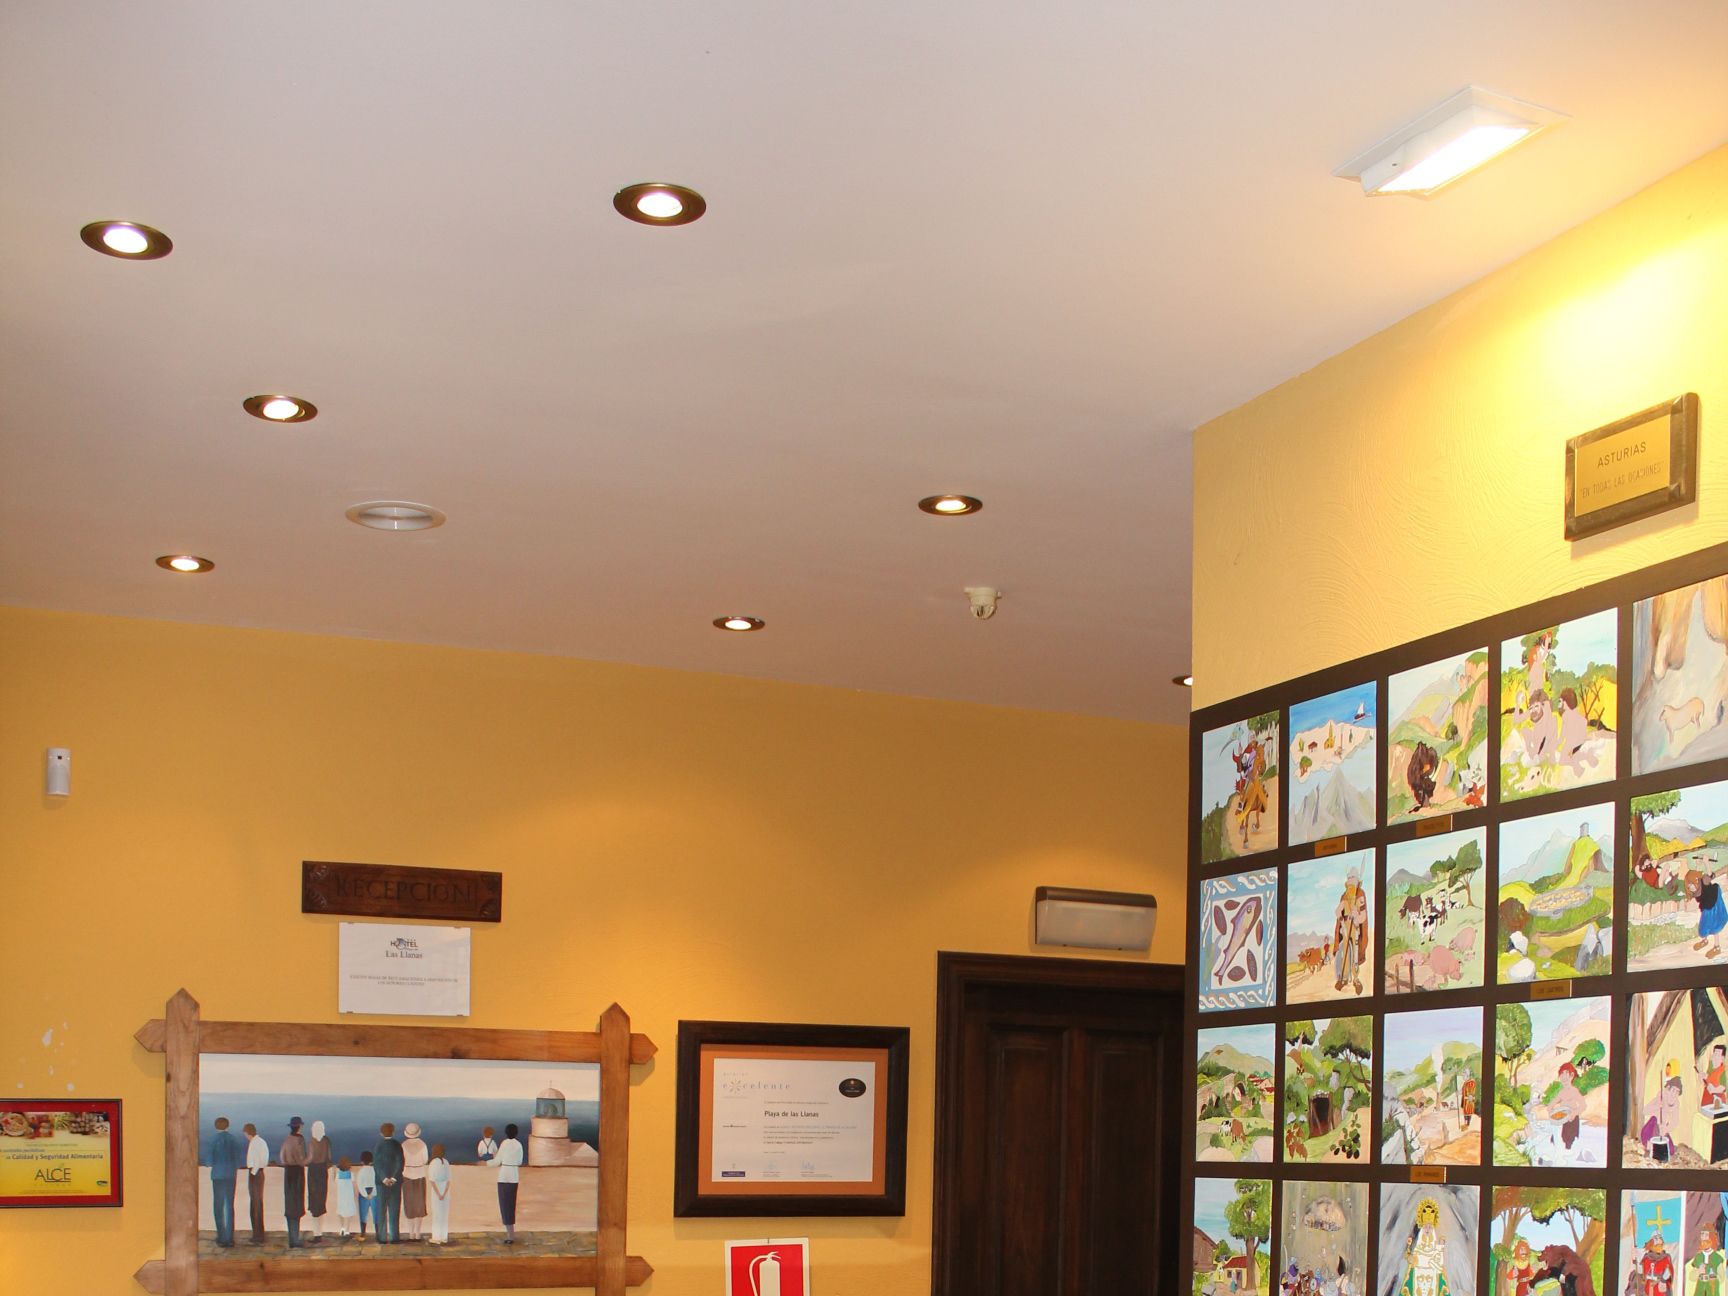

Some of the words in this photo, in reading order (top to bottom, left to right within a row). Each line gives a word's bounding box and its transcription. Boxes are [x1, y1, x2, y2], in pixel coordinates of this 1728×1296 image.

[1597, 441, 1647, 468] ASTURIAS
[764, 1110, 780, 1119] Playa
[781, 1110, 789, 1118] de
[790, 1110, 799, 1118] las
[800, 1110, 819, 1118] Llanas
[34, 1167, 72, 1182] ALCE
